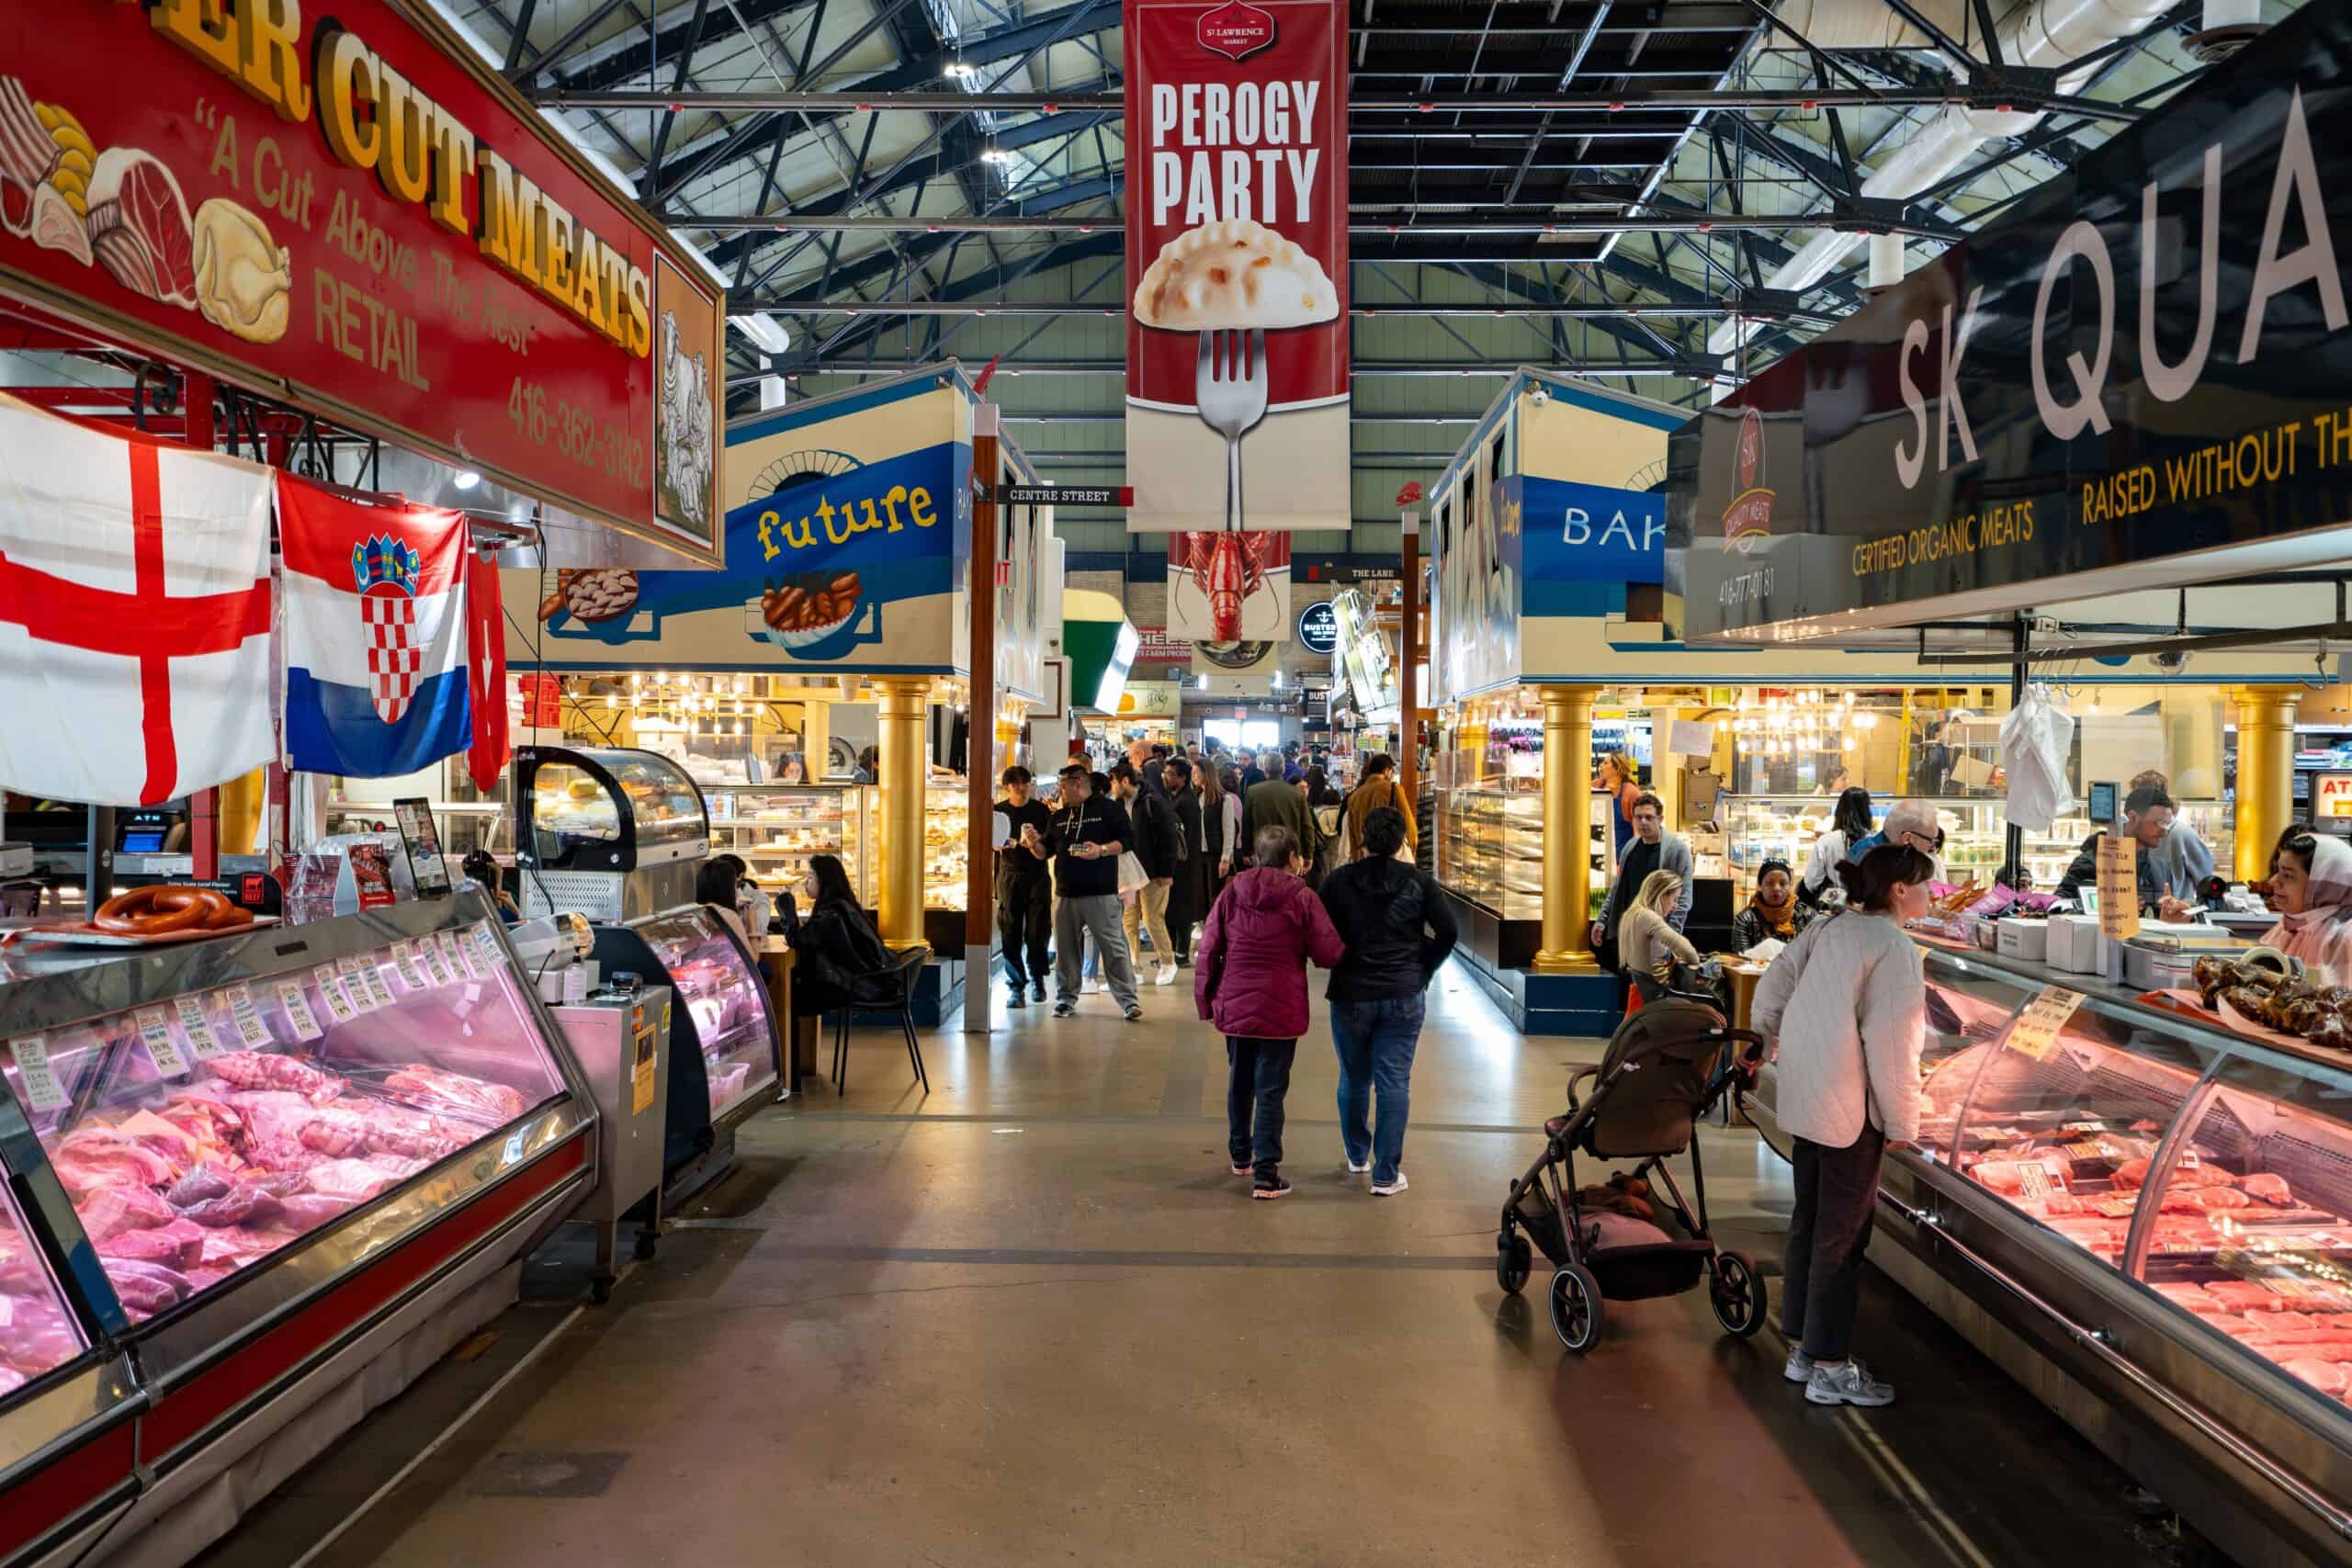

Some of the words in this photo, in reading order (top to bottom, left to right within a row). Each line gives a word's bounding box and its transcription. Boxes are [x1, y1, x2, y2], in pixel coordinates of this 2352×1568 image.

[1216, 28, 1264, 37] LAWRENCE
[1152, 81, 1320, 147] PEROGY
[318, 31, 475, 235] CUT
[478, 149, 652, 358] MEATS
[1153, 149, 1320, 226] PARTY
[254, 137, 314, 231] Cut
[325, 188, 419, 291] Above
[430, 250, 476, 319] The
[1894, 286, 1979, 489] SK
[2031, 83, 2350, 440] QUA
[313, 266, 429, 393] RETAIL
[509, 376, 646, 490] 416-362-3142
[1010, 489, 1057, 501] CENTRE
[1061, 491, 1110, 502] STREET
[2082, 466, 2156, 525] RAISED
[2166, 423, 2301, 502] WITHOUT
[757, 485, 937, 562] future
[1852, 533, 1905, 578] CERTIFIED
[1907, 514, 1976, 566] ORGANIC
[1979, 501, 2034, 549] MEATS
[1719, 567, 1774, 606] 416-777-0181
[2324, 780, 2352, 795] AT
